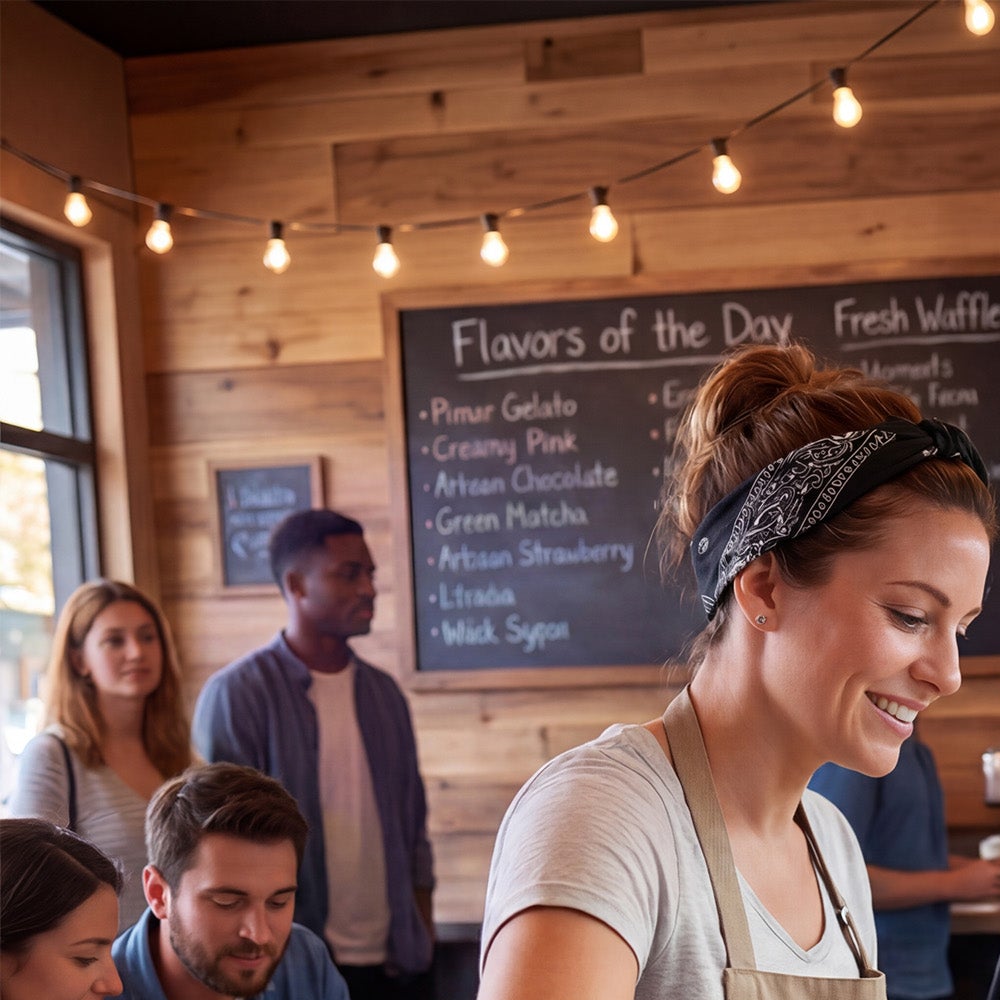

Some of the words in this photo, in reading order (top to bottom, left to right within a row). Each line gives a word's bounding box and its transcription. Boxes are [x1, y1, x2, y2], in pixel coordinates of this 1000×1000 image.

[452, 317, 587, 367] Flavors
[600, 307, 638, 353] of
[653, 308, 710, 351] the
[722, 302, 793, 346] Day
[834, 297, 909, 338] Fresh
[501, 391, 578, 422] Gelato
[432, 434, 517, 465] Creamy
[526, 427, 579, 456] Pink
[510, 460, 619, 494] Chocolate
[435, 505, 499, 536] Green
[505, 501, 588, 530] Matcha
[518, 538, 635, 573] Strawberry
